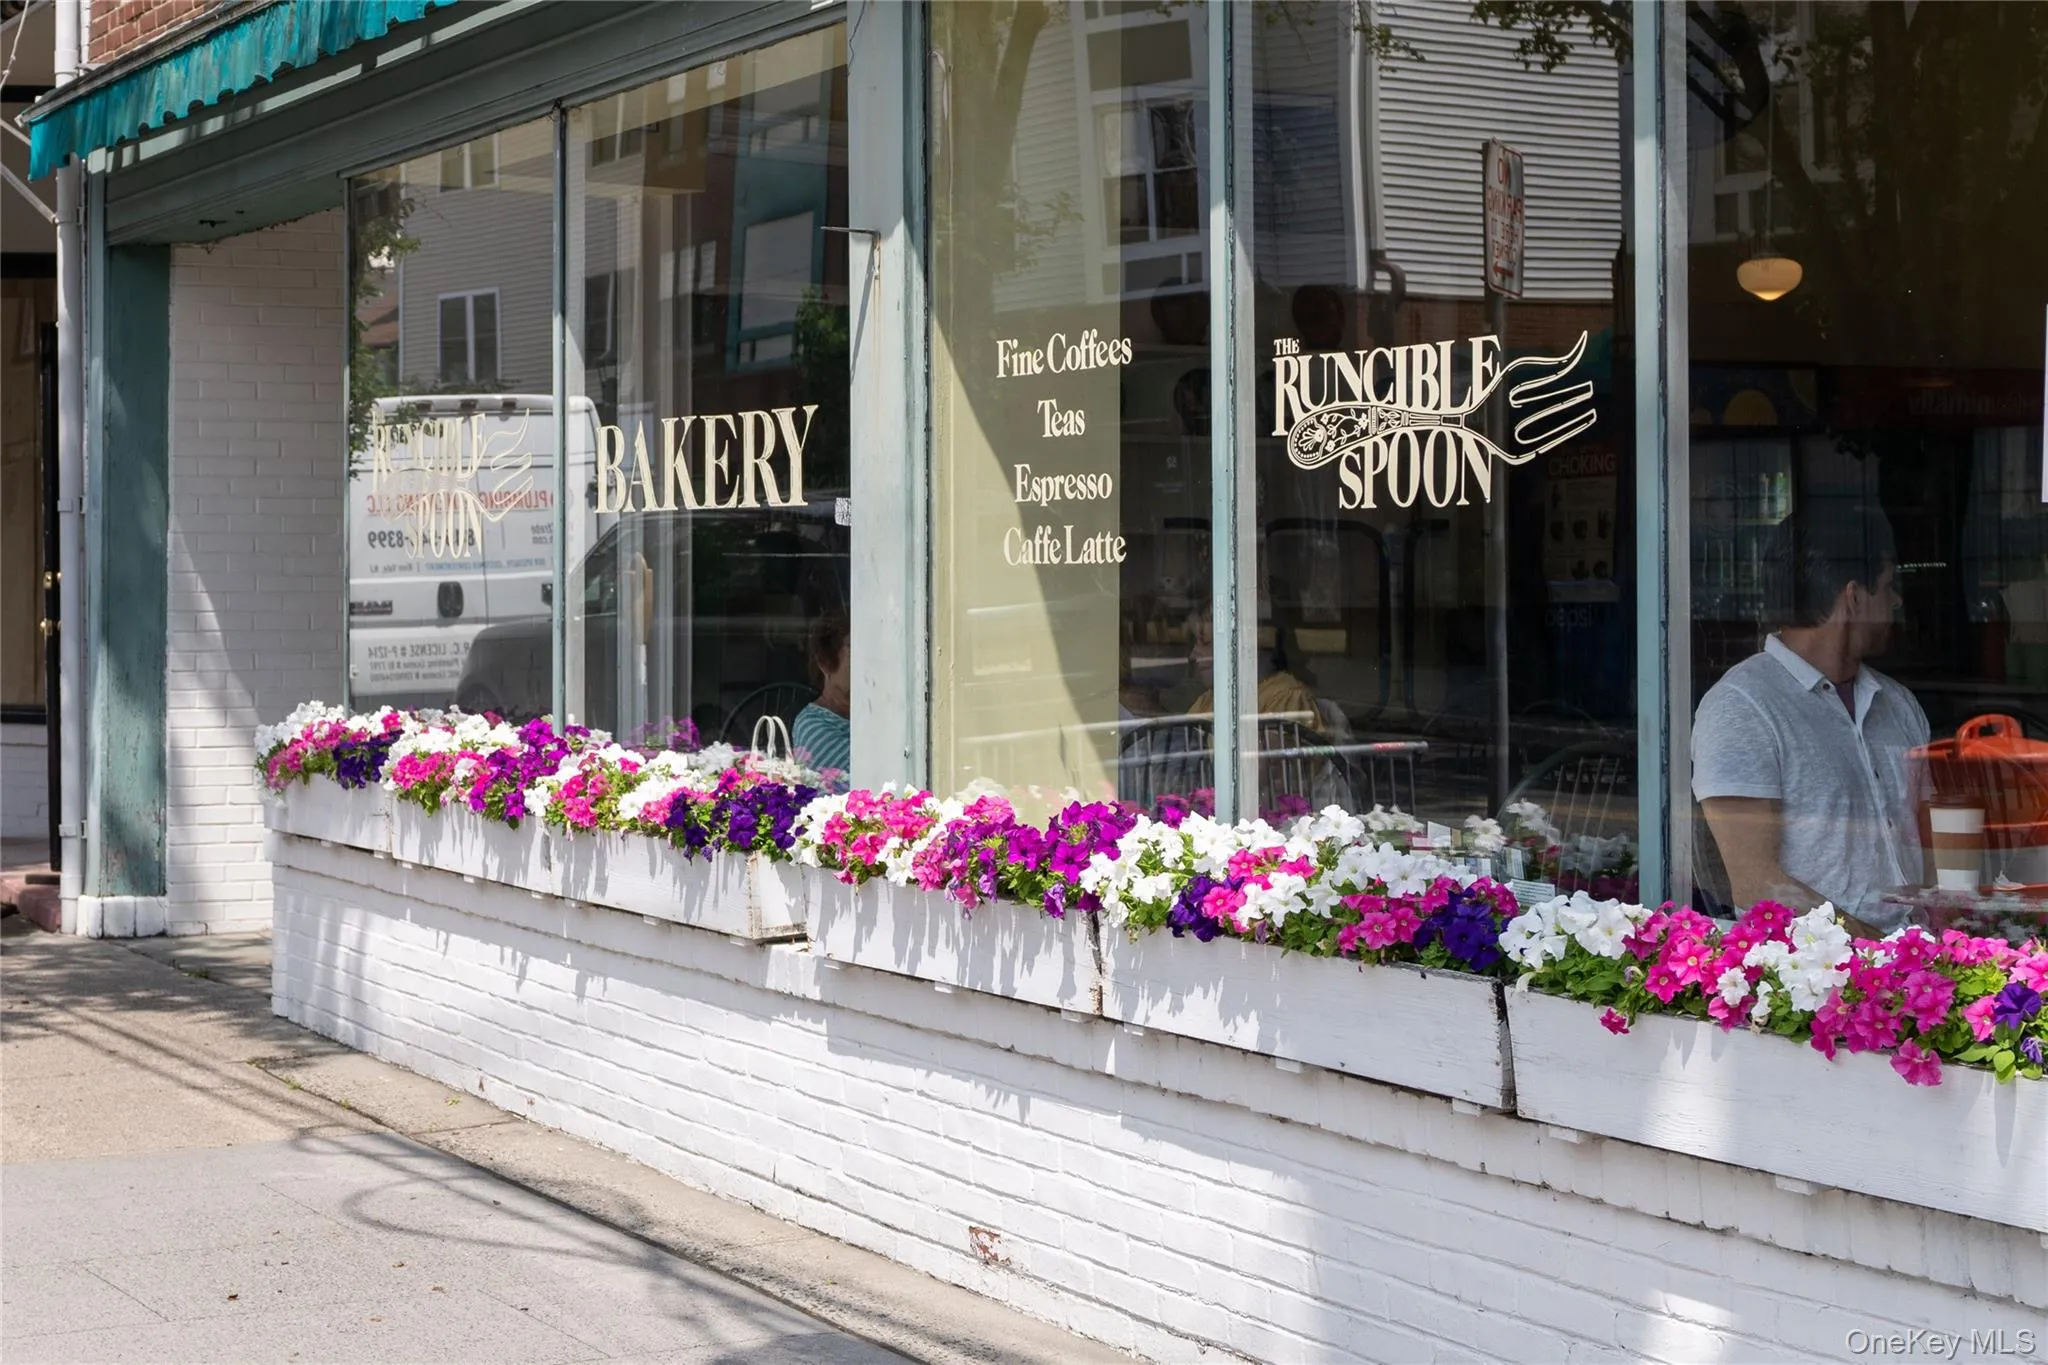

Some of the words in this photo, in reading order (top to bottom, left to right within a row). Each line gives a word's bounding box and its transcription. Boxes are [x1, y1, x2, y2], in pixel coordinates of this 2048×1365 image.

[996, 339, 1044, 378] Fine
[1047, 328, 1132, 373] Coffees
[1273, 338, 1300, 355] THE
[1272, 334, 1501, 436] RUNCIBLE
[1037, 399, 1086, 438] Teas
[594, 404, 819, 514] BAKERY
[1338, 428, 1495, 509] SPOON
[1548, 453, 1617, 477] CHOKING
[1014, 463, 1113, 507] Espresso
[1004, 525, 1062, 566] Caffe
[1064, 524, 1127, 564] Latte
